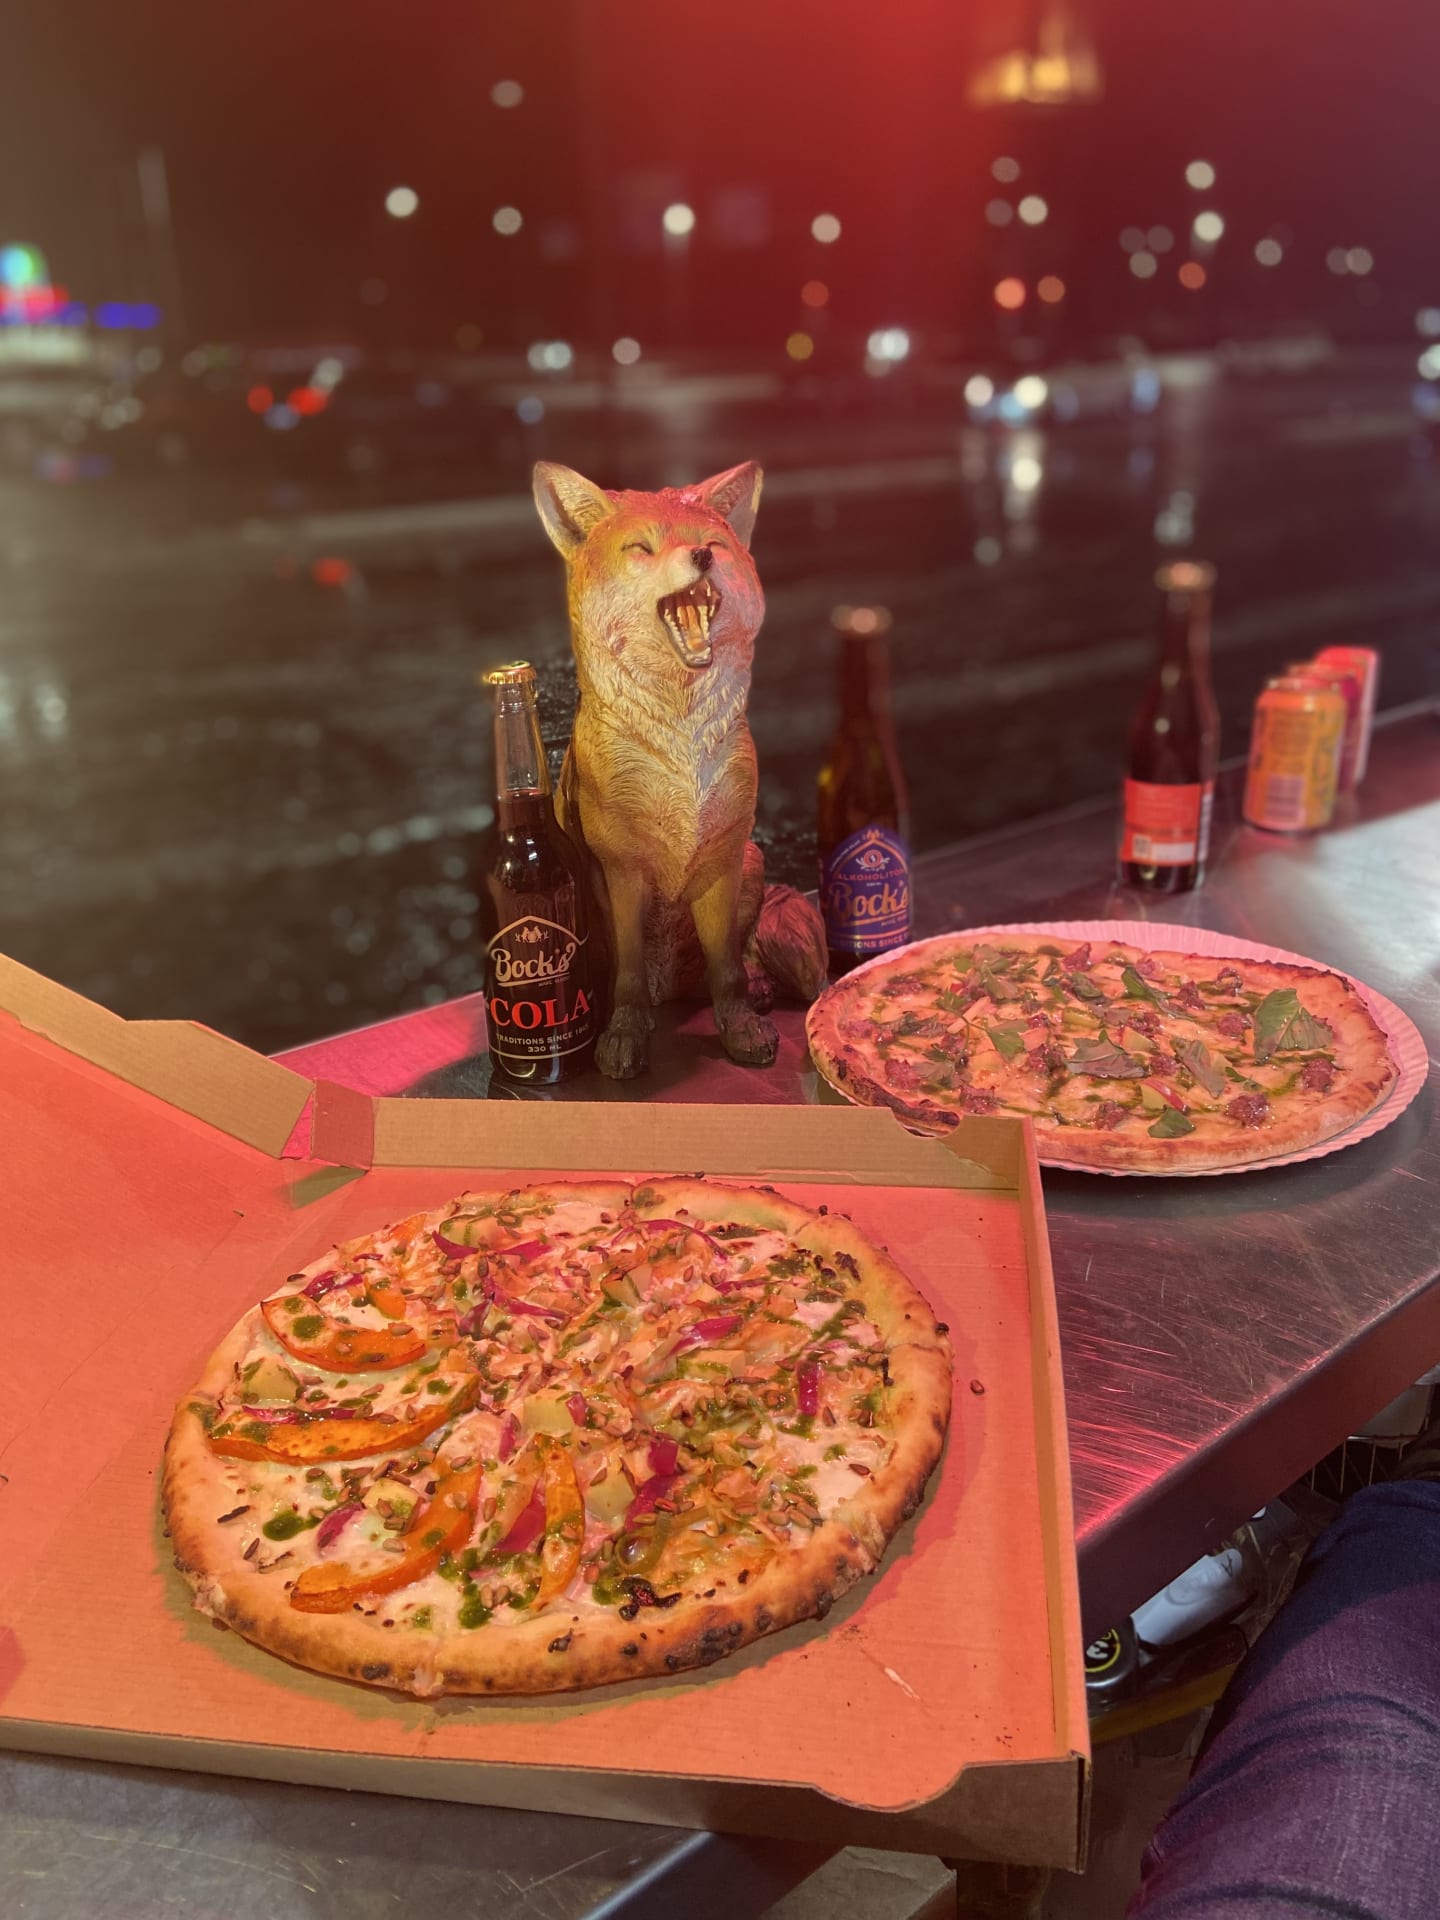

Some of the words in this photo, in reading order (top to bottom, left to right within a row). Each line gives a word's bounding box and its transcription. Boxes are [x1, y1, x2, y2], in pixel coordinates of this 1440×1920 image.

[828, 880, 909, 921] Bock's
[490, 942, 577, 982] Bock's
[489, 988, 591, 1030] COLA
[495, 1032, 545, 1045] TRADITIONS
[546, 1031, 573, 1044] SINCE
[527, 1045, 546, 1053] 330
